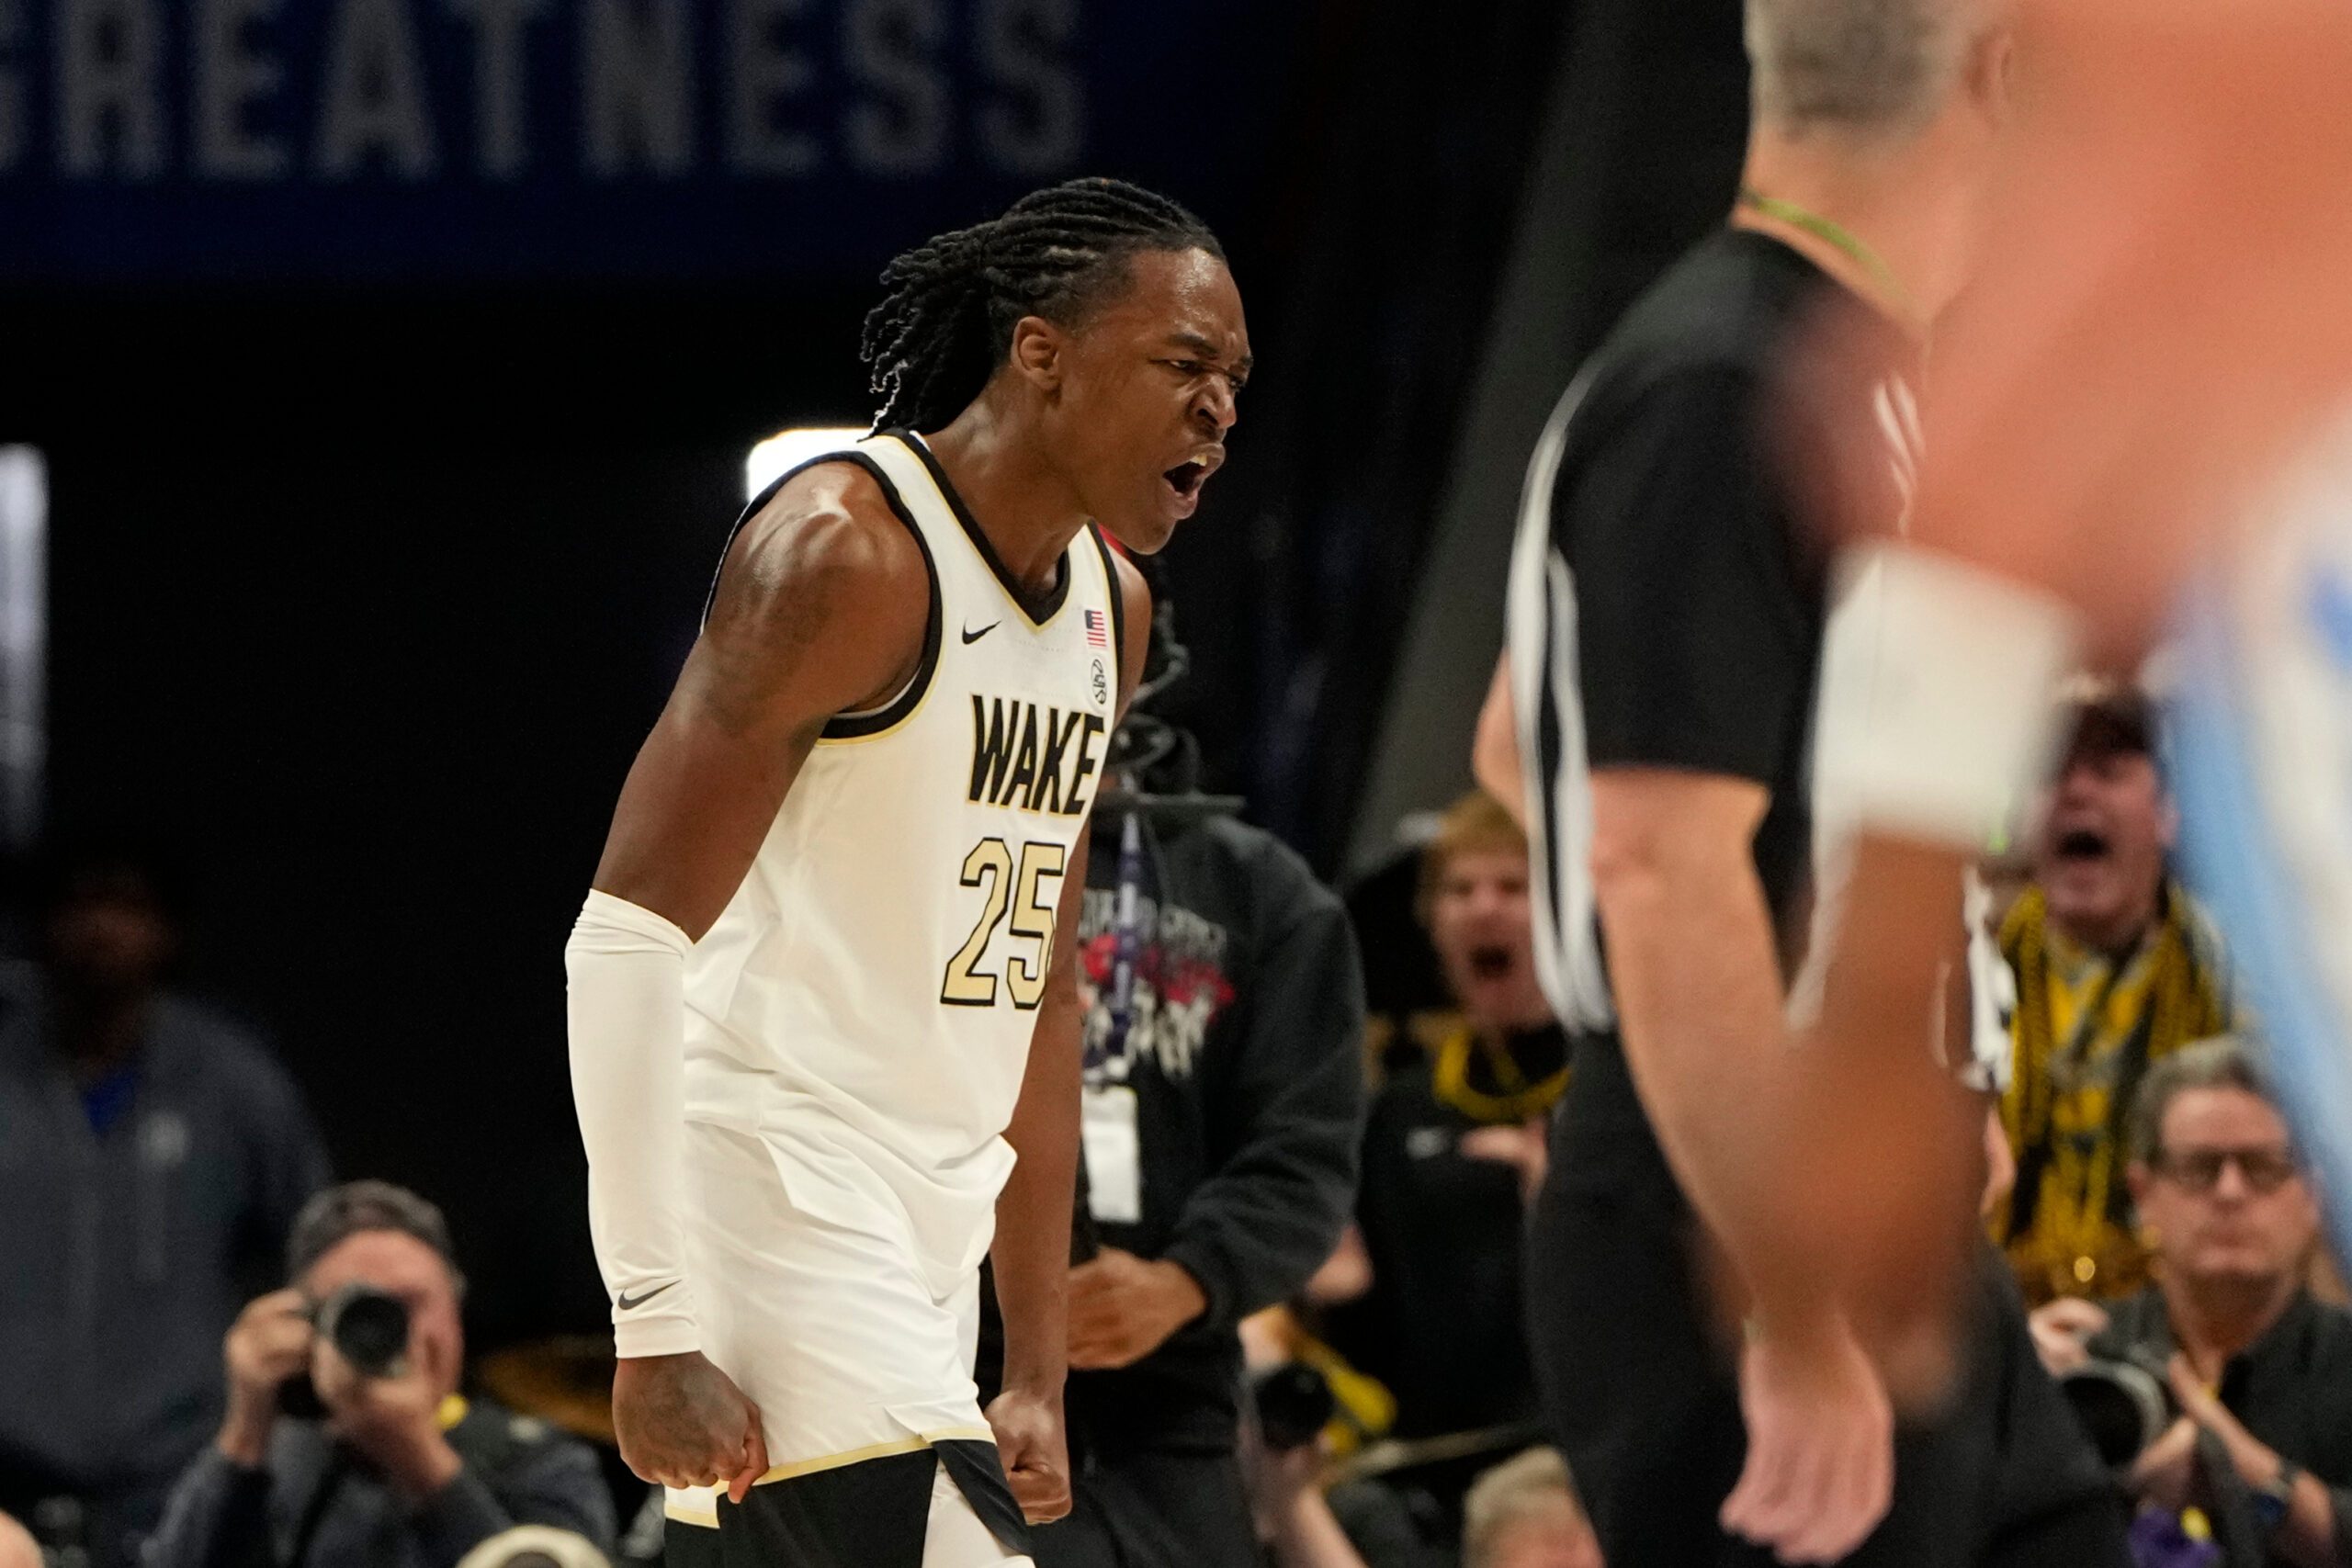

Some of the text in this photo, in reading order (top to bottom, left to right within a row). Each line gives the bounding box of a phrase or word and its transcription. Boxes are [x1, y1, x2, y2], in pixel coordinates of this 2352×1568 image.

[0, 0, 1086, 175] REATNESS
[967, 694, 1105, 816] WAKE
[940, 837, 1066, 1010] 25
